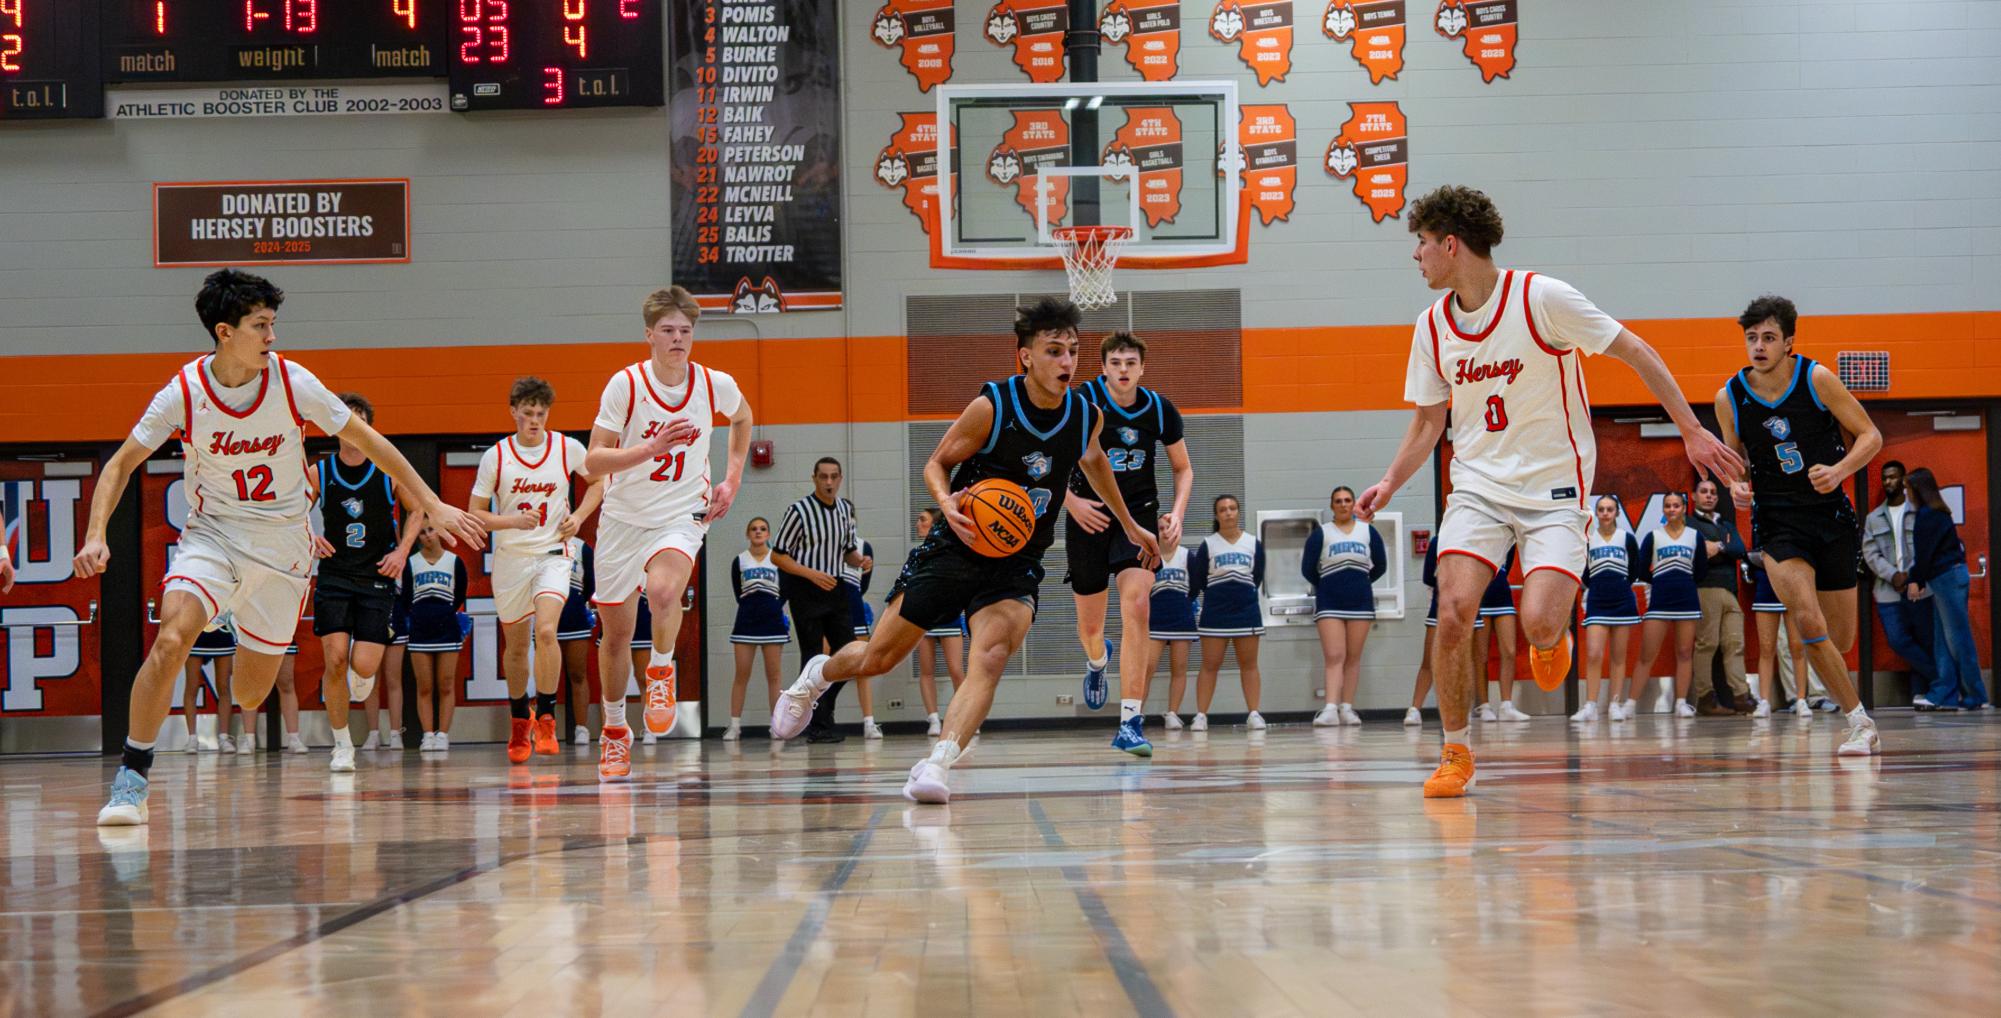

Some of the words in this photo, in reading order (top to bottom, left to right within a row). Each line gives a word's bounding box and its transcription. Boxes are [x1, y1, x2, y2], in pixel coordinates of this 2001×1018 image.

[704, 7, 716, 24] 3
[721, 6, 776, 23] POMIS
[461, 26, 508, 62] 23
[564, 26, 586, 59] 4
[704, 27, 716, 43] 4
[722, 26, 790, 43] WALTON
[120, 50, 176, 73] match
[239, 47, 305, 71] weight
[376, 45, 431, 67] match
[705, 47, 716, 63] 5
[722, 46, 777, 63] BURKE
[696, 66, 717, 83] 10
[722, 65, 779, 83] DIVITO
[219, 90, 283, 101] DONATED
[289, 89, 309, 100] BY
[314, 88, 339, 99] THE
[544, 67, 563, 104] 3
[697, 87, 717, 104] 11
[723, 86, 775, 103] IRWIN
[116, 102, 196, 117] ATHLETIC
[203, 101, 286, 115] BOOSTER
[293, 100, 339, 114] CLUB
[346, 98, 443, 113] 2002-2003
[697, 107, 718, 123] 12
[723, 106, 765, 123] BAIK
[1029, 121, 1048, 131] 3RD
[1141, 118, 1162, 128] 4TH
[1256, 116, 1275, 126] 3RD
[1359, 122, 1393, 132] STATE
[1365, 113, 1386, 123] 7TH
[697, 127, 718, 144] 15
[723, 126, 775, 143] FAHEY
[910, 132, 937, 142] STAT
[1023, 130, 1056, 140] STATE
[1135, 126, 1168, 136] STATE
[1248, 125, 1282, 135] STATE
[696, 146, 719, 164] 20
[724, 145, 805, 163] PETERSON
[696, 166, 718, 183] 21
[724, 165, 796, 183] NAWROT
[222, 193, 310, 216] DONATED
[316, 191, 344, 213] BY
[696, 186, 720, 204] 22
[724, 185, 794, 203] MCNEILL
[697, 207, 719, 223] 24
[724, 205, 775, 223] LEYVA
[191, 217, 266, 240] HERSEY
[271, 215, 374, 239] BOOSTERS
[697, 226, 720, 243] 25
[724, 225, 773, 243] BALIS
[253, 241, 312, 254] 2024-2025
[698, 246, 720, 264] 34
[726, 245, 795, 263] TROTTER
[1455, 357, 1524, 386] Hersey
[1485, 395, 1509, 433] 0
[208, 431, 285, 457] Hersey
[649, 451, 686, 482] 21
[1107, 447, 1147, 472] 23
[1774, 441, 1805, 475] 5
[232, 464, 278, 502] 12
[510, 477, 558, 498] Hersey
[345, 523, 366, 548] 2
[988, 520, 1021, 548] NCAA
[2, 605, 82, 711] P
